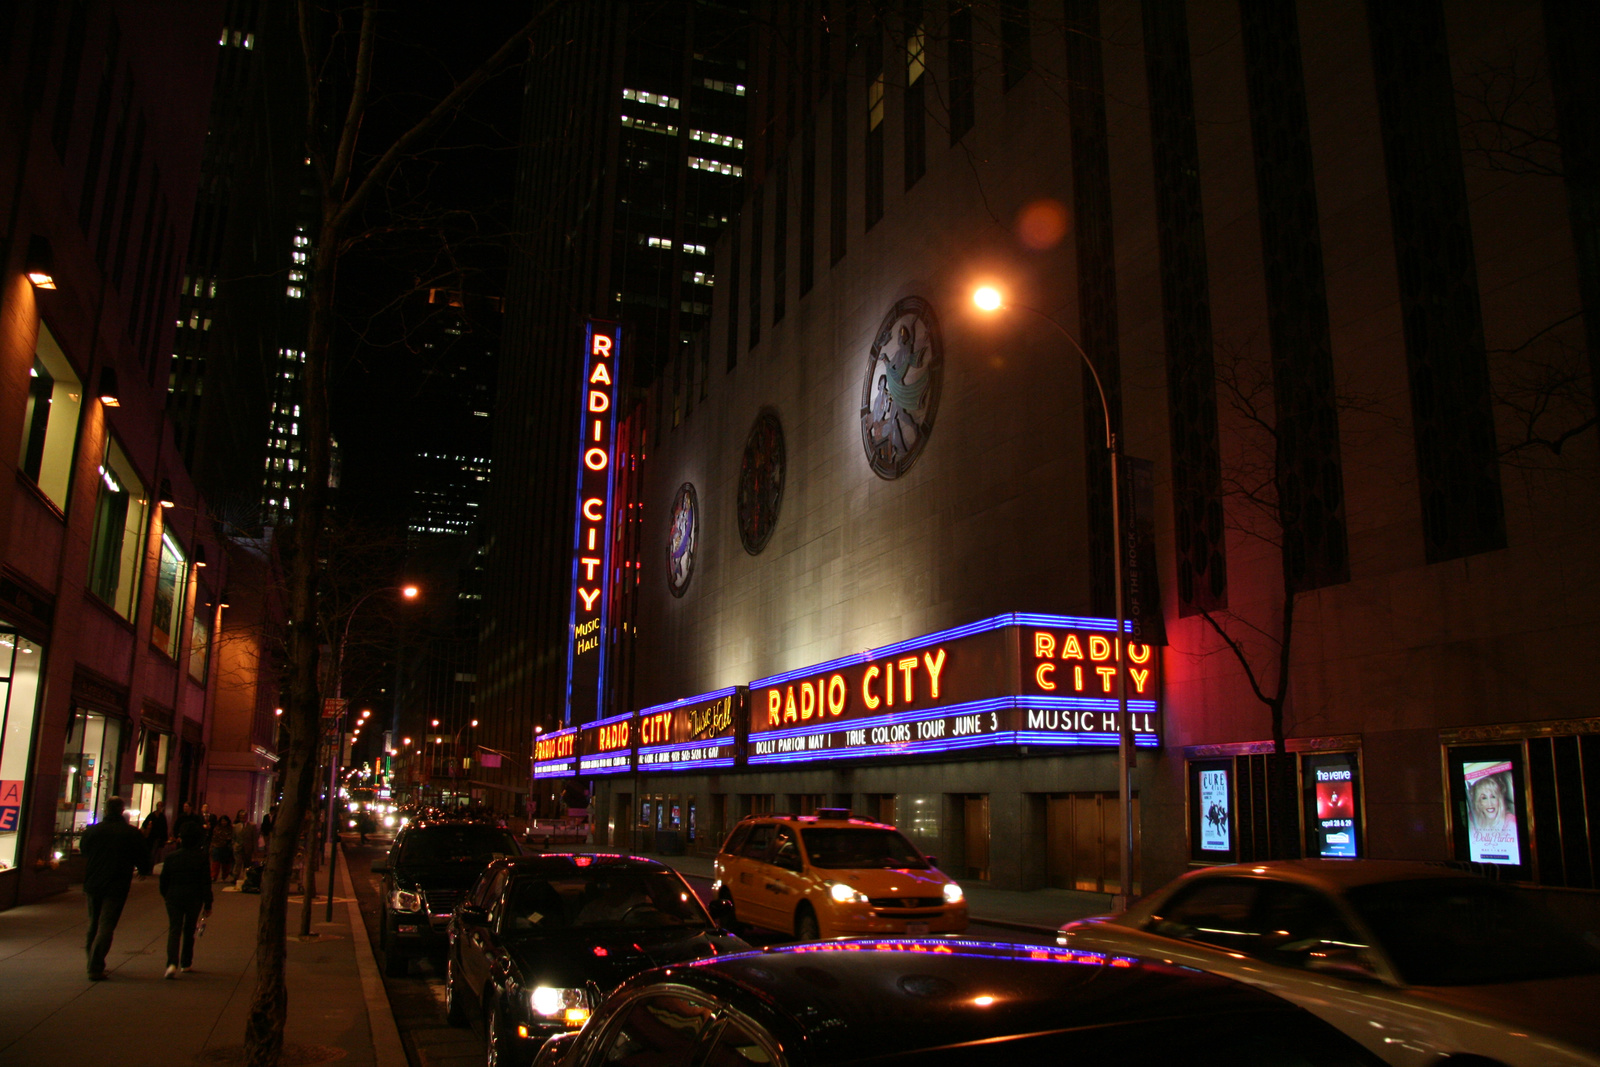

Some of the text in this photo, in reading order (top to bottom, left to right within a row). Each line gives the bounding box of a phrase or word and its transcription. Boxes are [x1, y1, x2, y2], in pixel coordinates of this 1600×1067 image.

[585, 334, 612, 471] RADIO
[578, 498, 603, 611] CITY
[1035, 632, 1150, 663] RADIO
[768, 648, 946, 726] RADIO CITY
[1036, 662, 1149, 693] CITY
[600, 721, 629, 751] RADIO
[642, 712, 673, 744] CITY
[756, 740, 776, 754] DOLLY
[778, 736, 805, 752] PARTON
[808, 734, 824, 749] MAY
[846, 729, 866, 746] TRUE
[872, 723, 911, 744] COLORS
[917, 719, 945, 739] TOUR
[952, 714, 981, 736] JUNE
[990, 712, 998, 731] 3
[1028, 709, 1154, 732] MUSIC HLL
[538, 734, 574, 760] RADIO CITY
[1203, 773, 1224, 789] CURE
[1316, 770, 1351, 781] the verve
[1321, 820, 1333, 828] april
[1473, 830, 1514, 843] Dolly Parton
